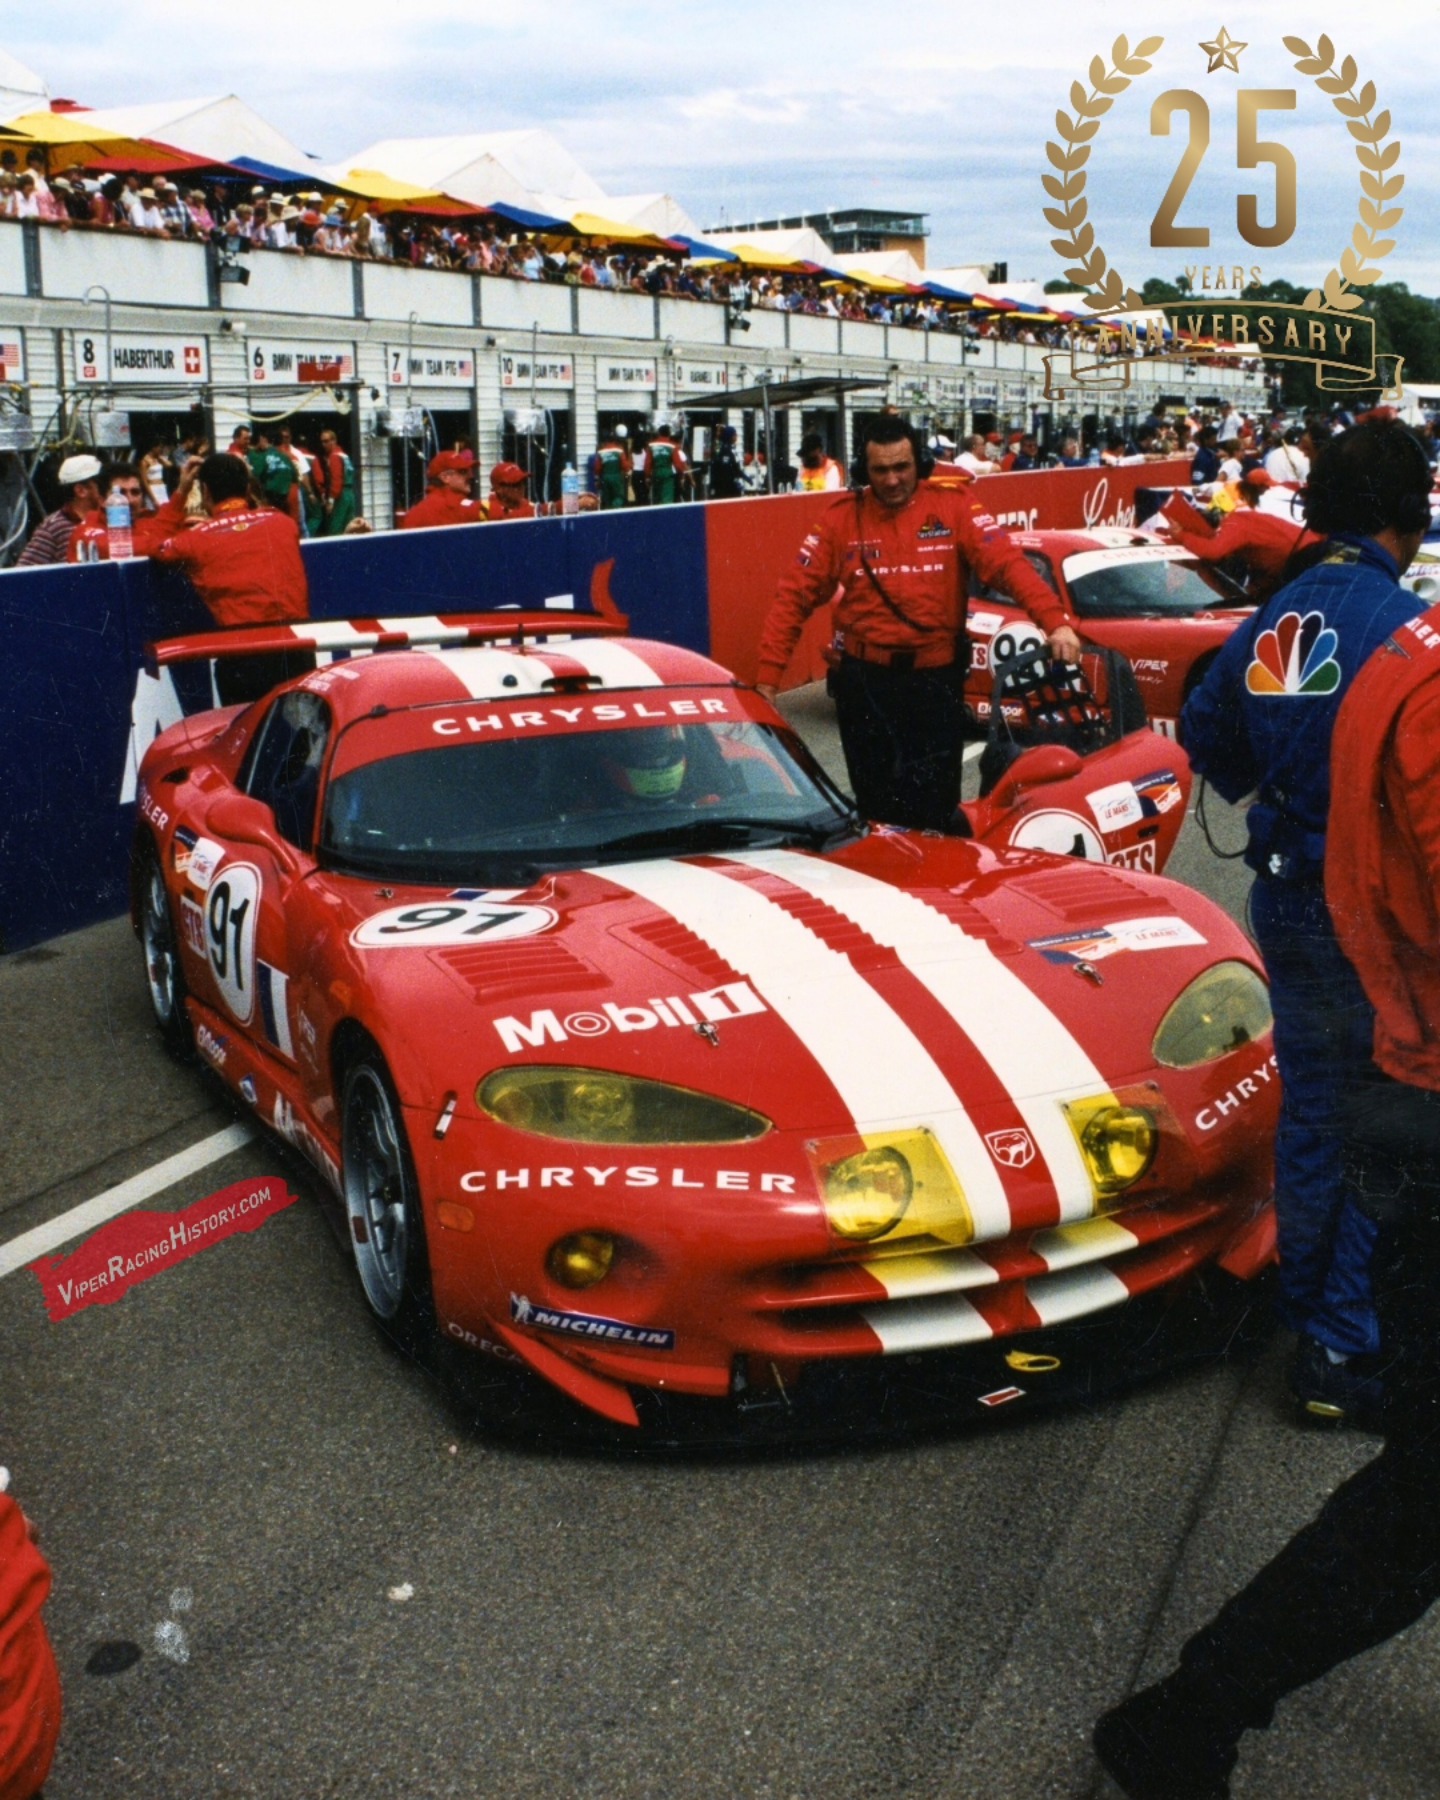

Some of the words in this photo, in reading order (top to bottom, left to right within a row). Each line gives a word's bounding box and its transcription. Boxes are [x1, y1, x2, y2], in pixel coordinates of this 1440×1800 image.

[83, 339, 95, 363] 8
[113, 348, 175, 369] HABERTHUR
[253, 347, 264, 367] 6
[392, 352, 401, 371] 7
[272, 354, 293, 371] BMW
[502, 358, 513, 375] 10
[1130, 658, 1169, 676] VIPER
[432, 698, 728, 735] CHRYSLER
[1104, 808, 1114, 819] LE
[379, 907, 525, 936] 91
[210, 881, 250, 991] 91
[493, 997, 699, 1053] Mobil
[709, 990, 742, 1015] 1
[460, 1166, 796, 1193] CHRYSLER
[535, 1311, 668, 1345] MICHELIN
